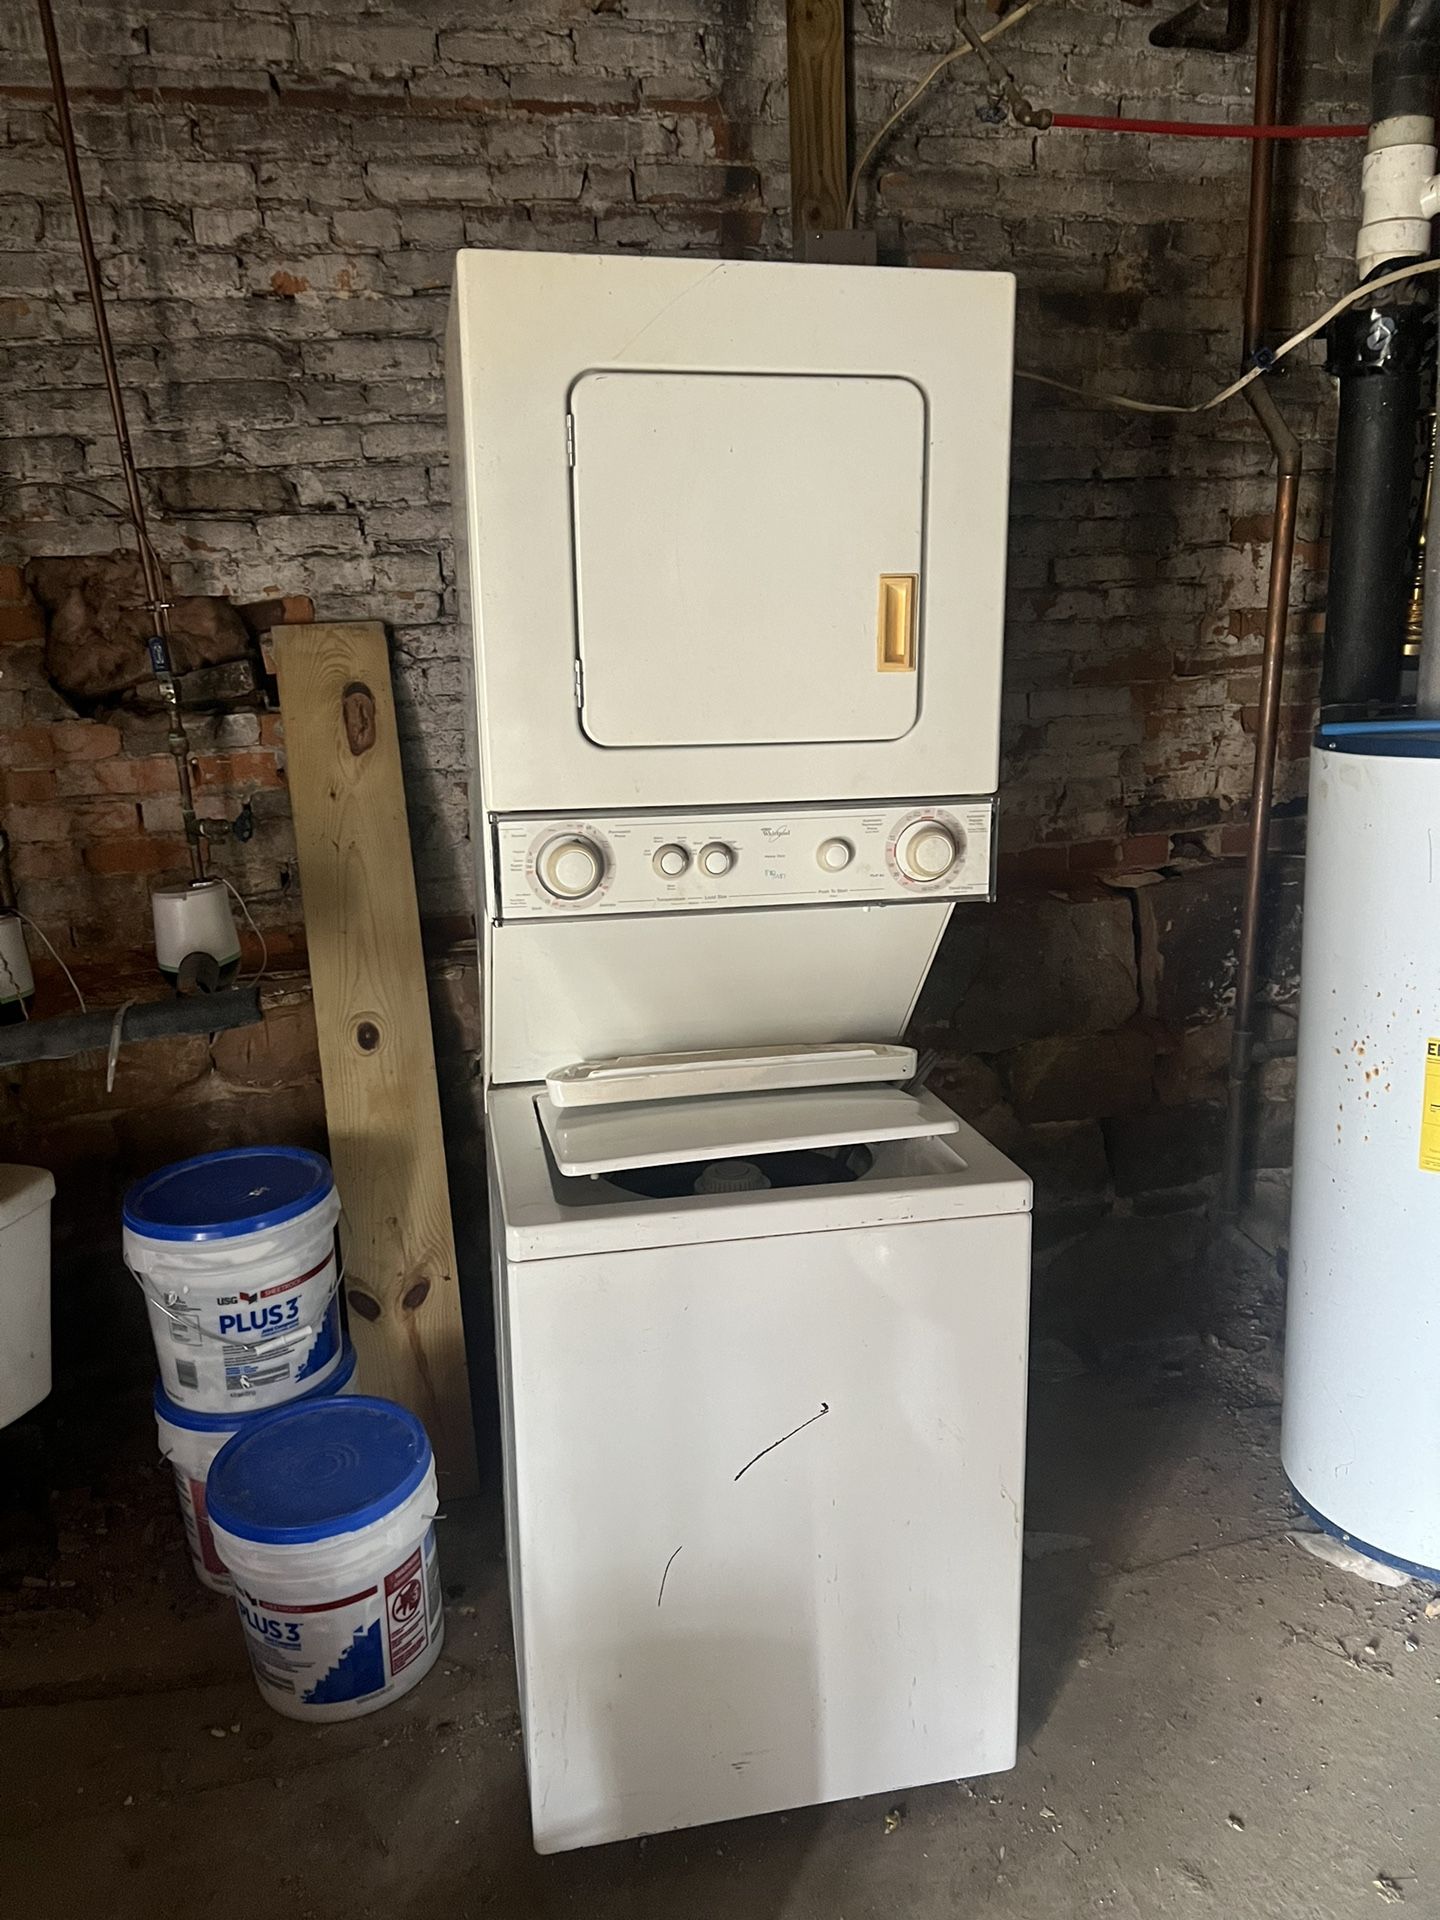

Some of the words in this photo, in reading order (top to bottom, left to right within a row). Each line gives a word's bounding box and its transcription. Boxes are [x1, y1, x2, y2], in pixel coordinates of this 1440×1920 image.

[217, 1296, 238, 1306] USG
[219, 1304, 283, 1334] PLUS
[286, 1297, 299, 1319] 3
[238, 1599, 283, 1639] PLUS
[284, 1622, 300, 1641] 3
